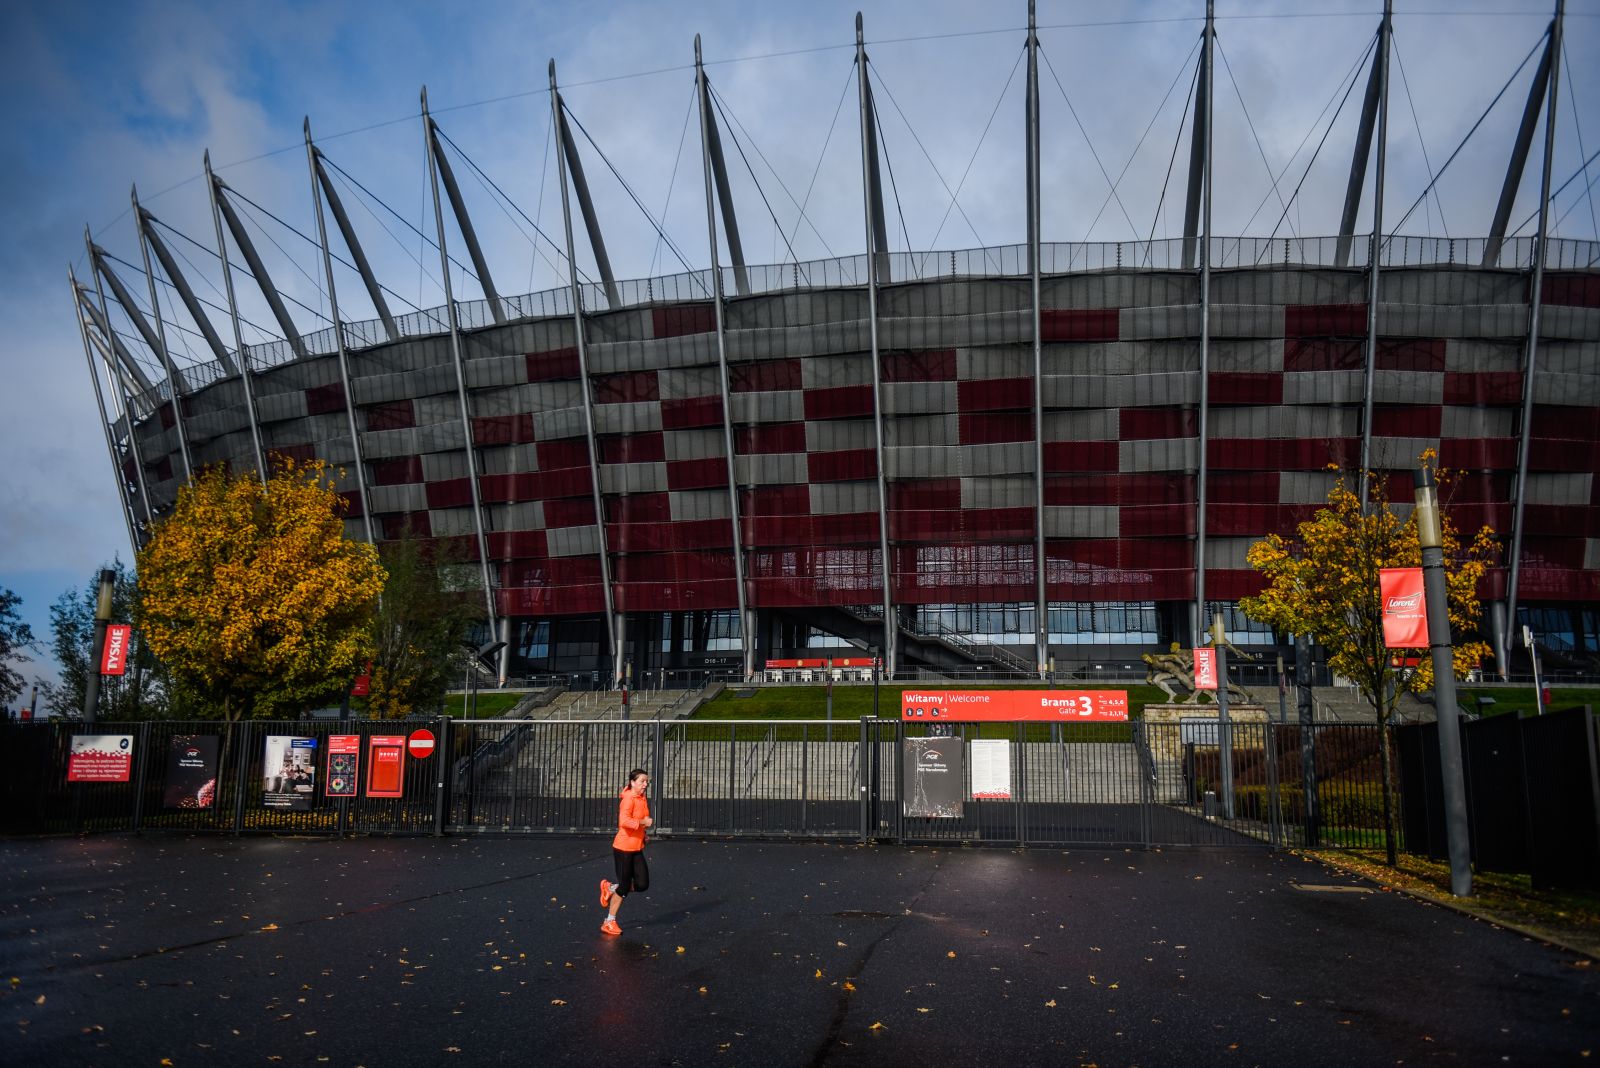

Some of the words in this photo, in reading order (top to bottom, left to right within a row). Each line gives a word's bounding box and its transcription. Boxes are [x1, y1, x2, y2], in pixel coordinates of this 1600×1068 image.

[1389, 598, 1416, 607] Lorenz
[107, 628, 124, 671] TYSKIE
[1200, 651, 1210, 686] TYSKIE
[905, 694, 943, 705] Witamy
[949, 694, 990, 703] Welcome
[1041, 698, 1076, 707] Brama
[1078, 696, 1093, 716] 3
